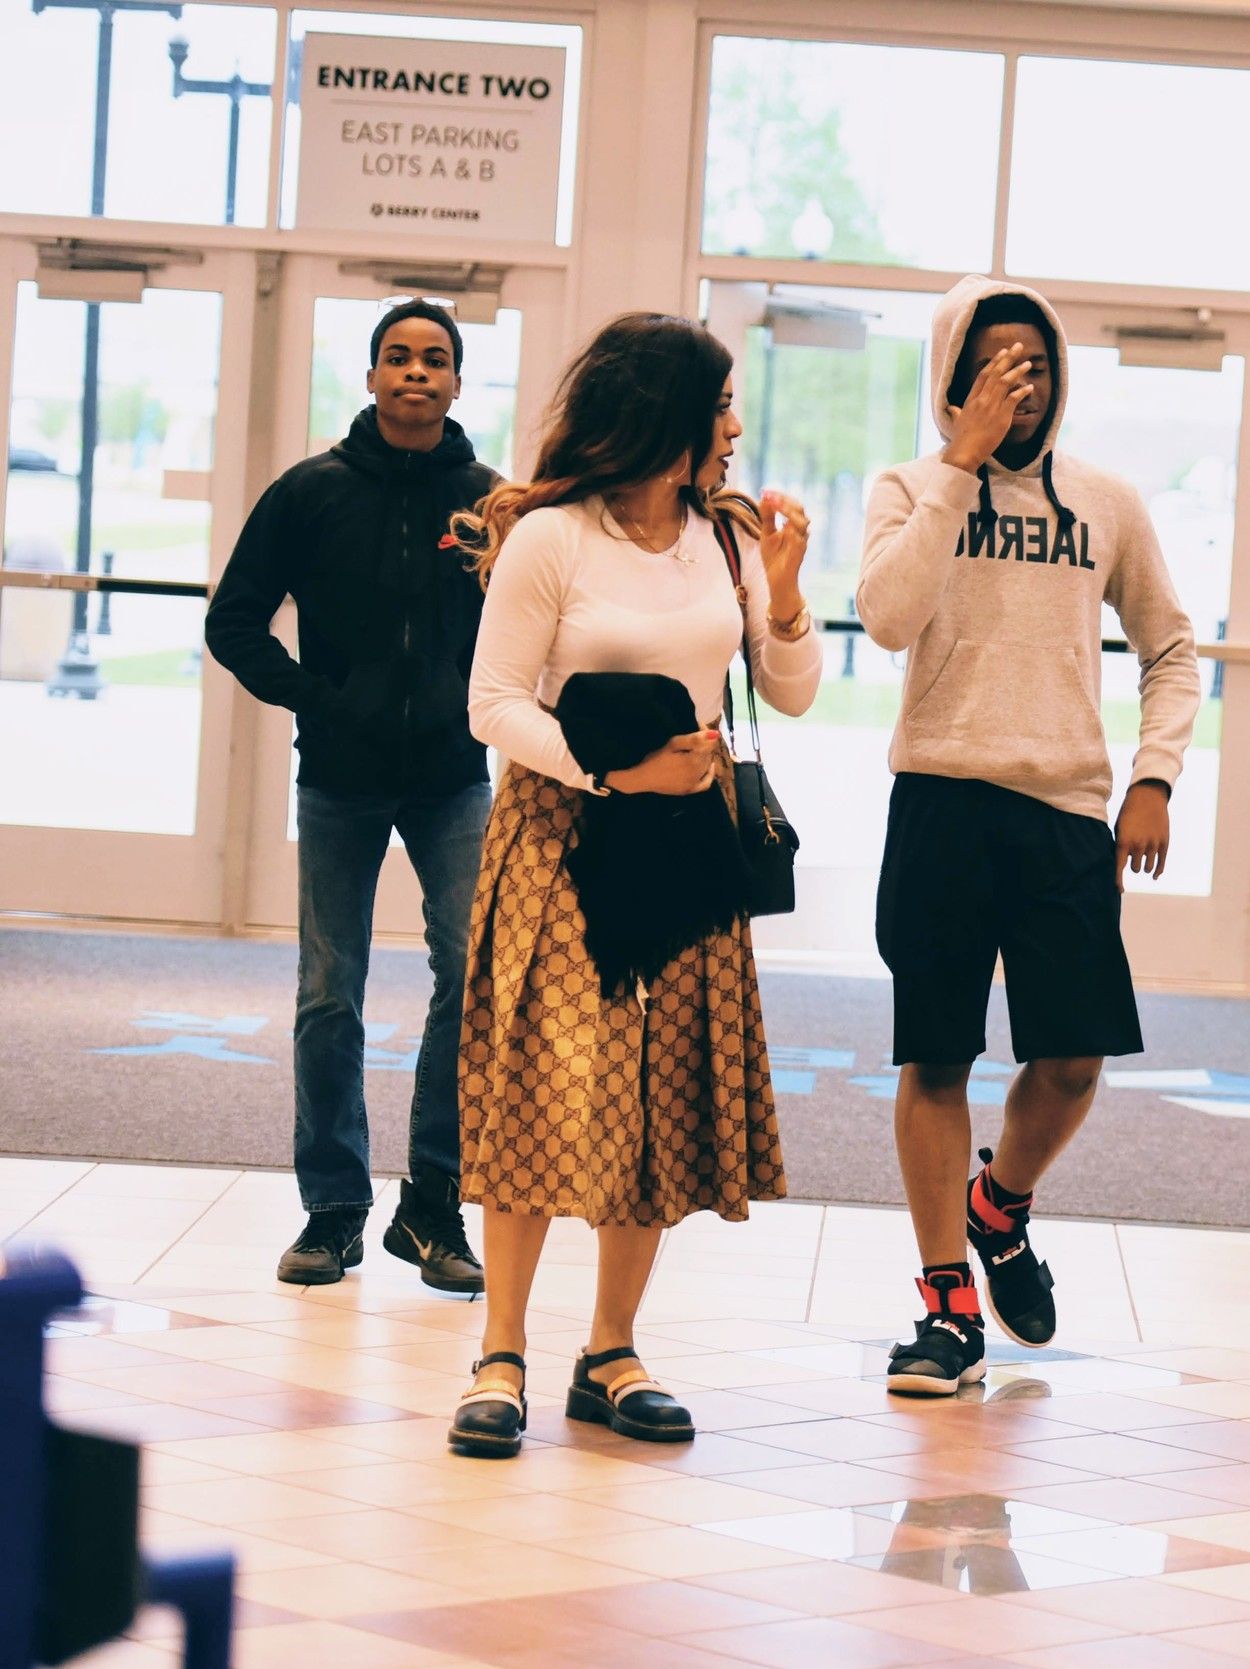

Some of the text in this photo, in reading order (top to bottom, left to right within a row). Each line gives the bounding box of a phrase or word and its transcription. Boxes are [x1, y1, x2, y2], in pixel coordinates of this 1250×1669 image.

[318, 65, 551, 100] ENTRANCE TWO
[341, 119, 520, 152] EAST PARKING
[361, 151, 496, 182] LOTS A & B
[431, 207, 480, 221] CENTER
[954, 512, 1096, 570] NREAL
